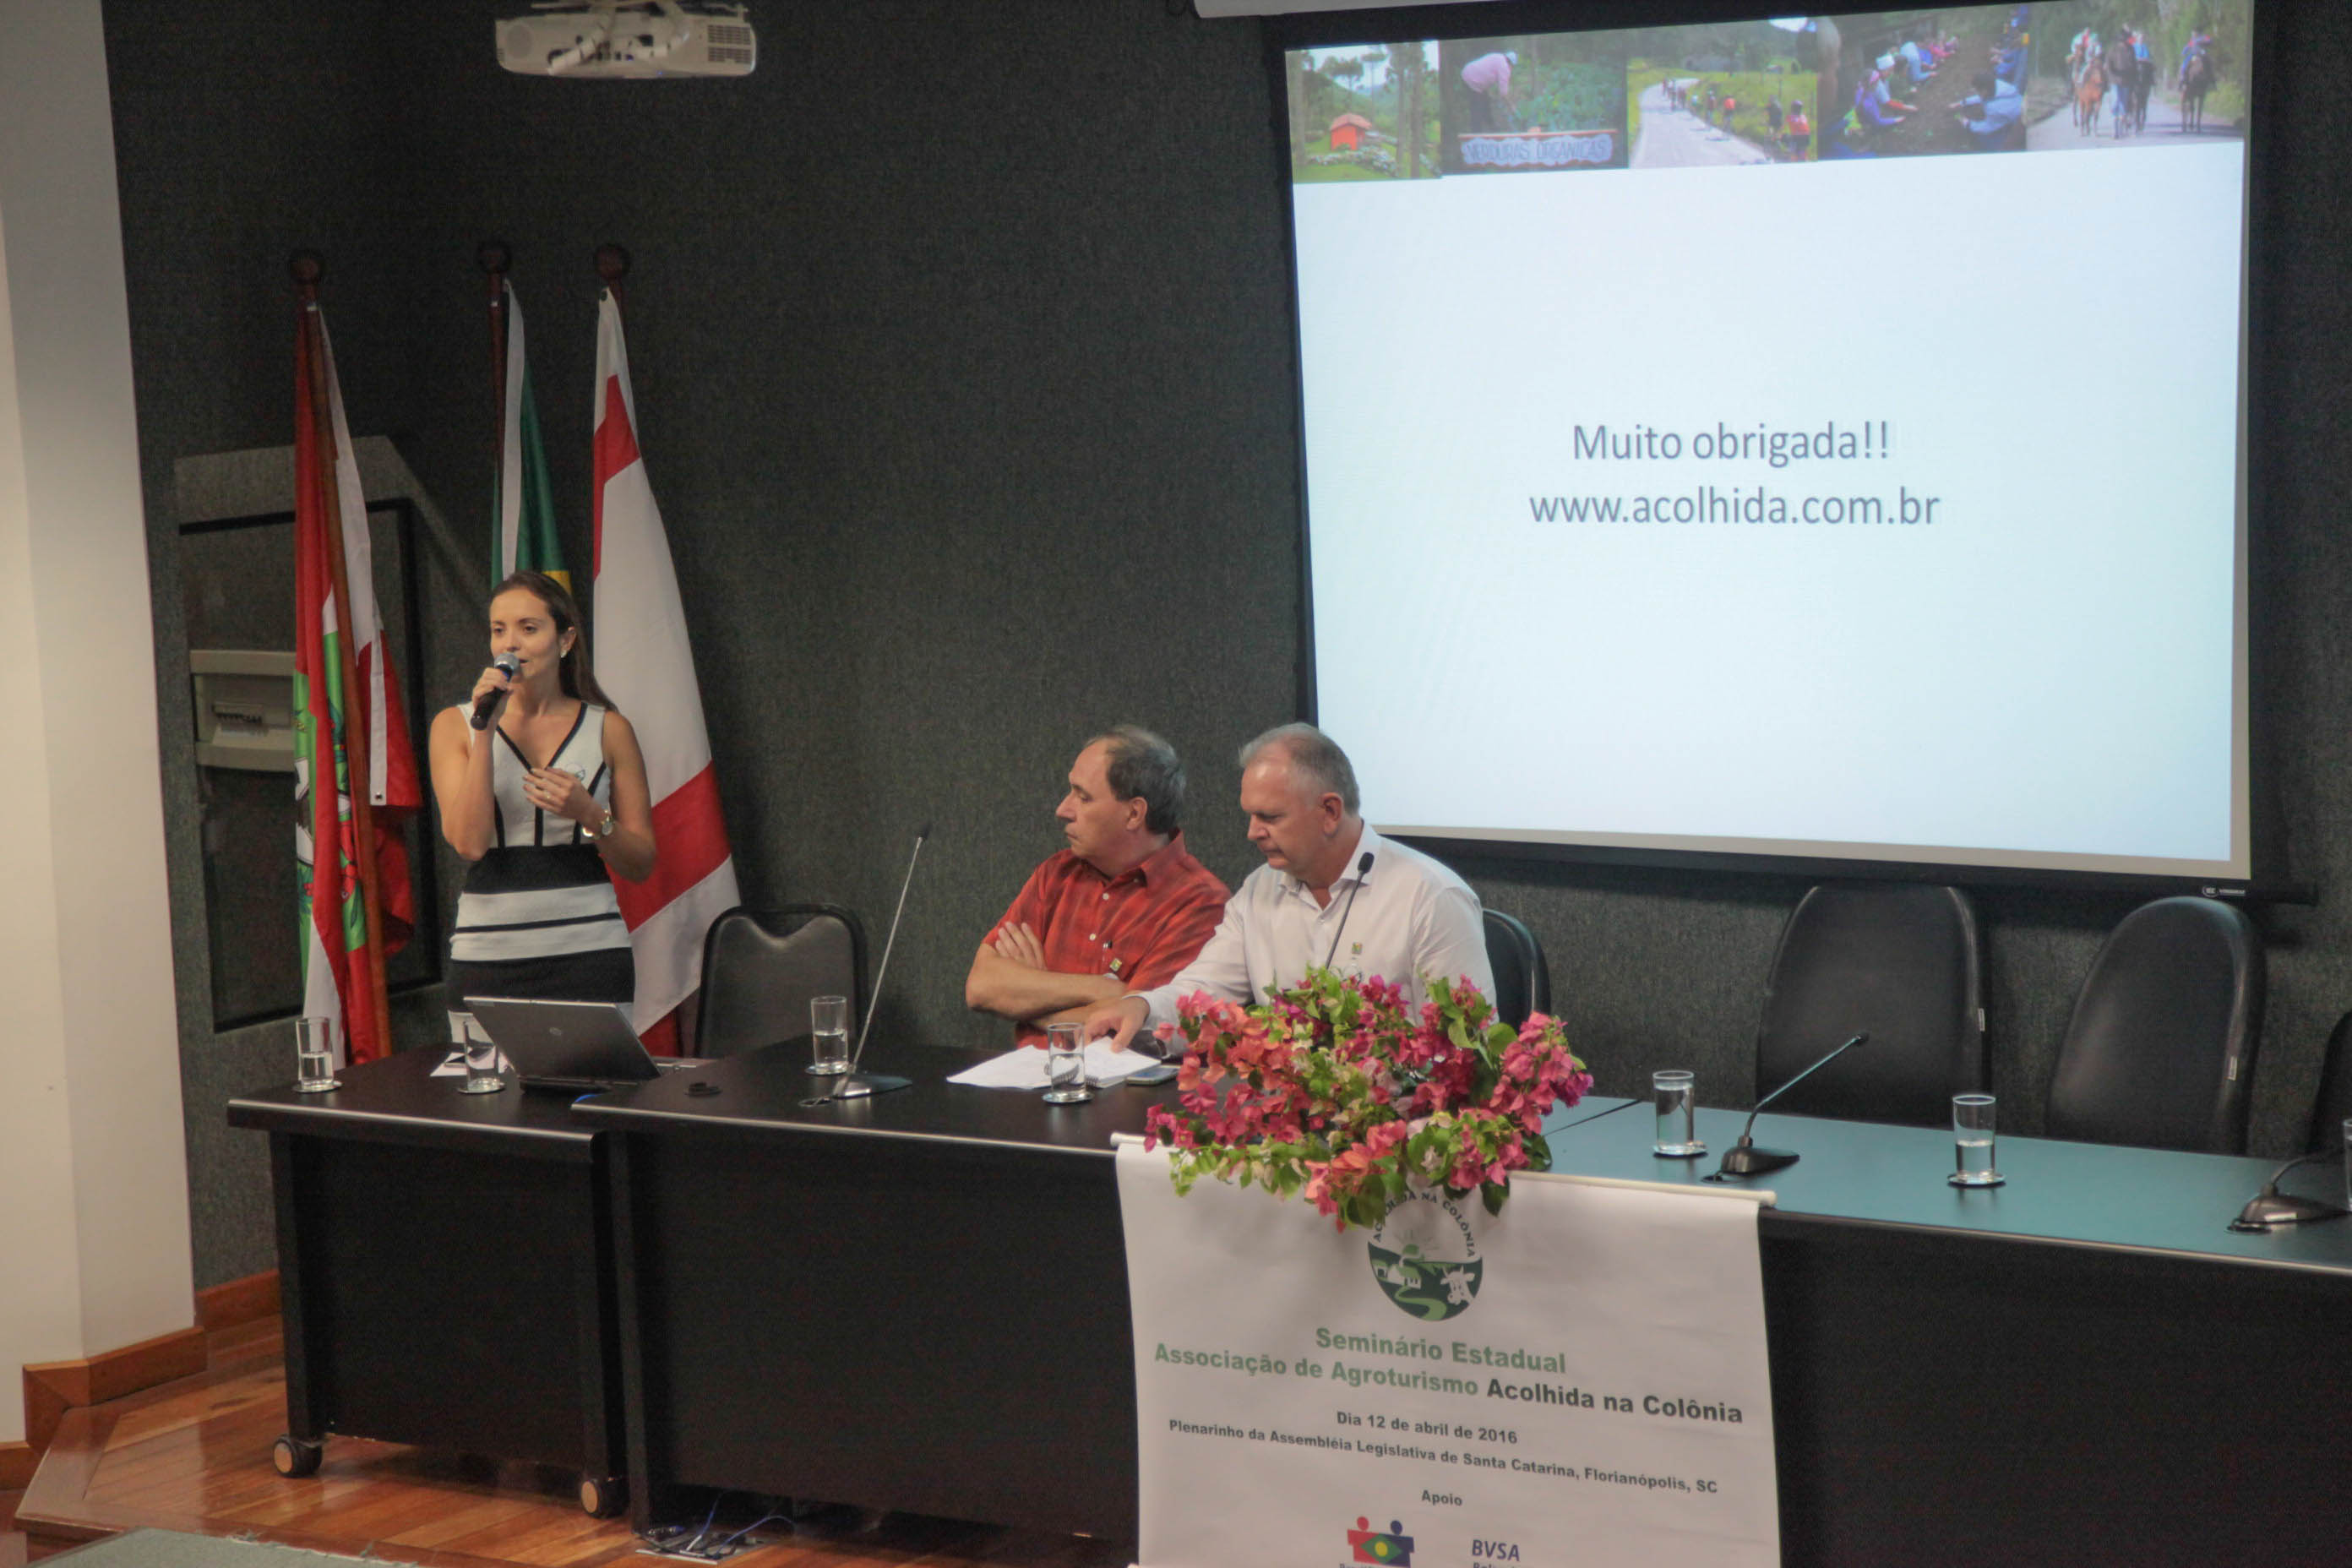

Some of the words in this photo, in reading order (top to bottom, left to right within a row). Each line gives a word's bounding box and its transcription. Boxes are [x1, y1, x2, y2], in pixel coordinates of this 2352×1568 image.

[1573, 424, 1682, 460] Muito
[1692, 421, 1889, 468] obrigada!!
[1529, 486, 1941, 525] www.acolhida.com.br
[1421, 1192, 1437, 1203] NA
[1315, 1327, 1444, 1360] Seminário
[1451, 1341, 1566, 1374] Estadual
[1155, 1342, 1288, 1376] Associação
[1294, 1358, 1323, 1378] de
[1331, 1361, 1479, 1396] Agroturismo
[1487, 1378, 1595, 1409] Acolhida
[1603, 1395, 1634, 1413] na
[1643, 1395, 1744, 1424] Colônia
[1337, 1412, 1362, 1426] Dia
[1367, 1414, 1386, 1429] 12
[1391, 1418, 1409, 1431] de
[1415, 1422, 1449, 1436] abril
[1454, 1426, 1473, 1439] de
[1478, 1428, 1518, 1445] 2016
[1169, 1419, 1244, 1439] Plenarinho
[1248, 1429, 1266, 1440] da
[1270, 1430, 1352, 1451] Assembléia
[1357, 1440, 1436, 1462] Legislativa
[1440, 1451, 1458, 1463] de
[1463, 1453, 1506, 1470] Santa
[1511, 1459, 1580, 1480] Catarina,
[1584, 1467, 1691, 1493] Florianópolis,
[1696, 1480, 1718, 1494] SC
[1422, 1489, 1463, 1506] Apoio
[1472, 1539, 1521, 1562] BVSA
